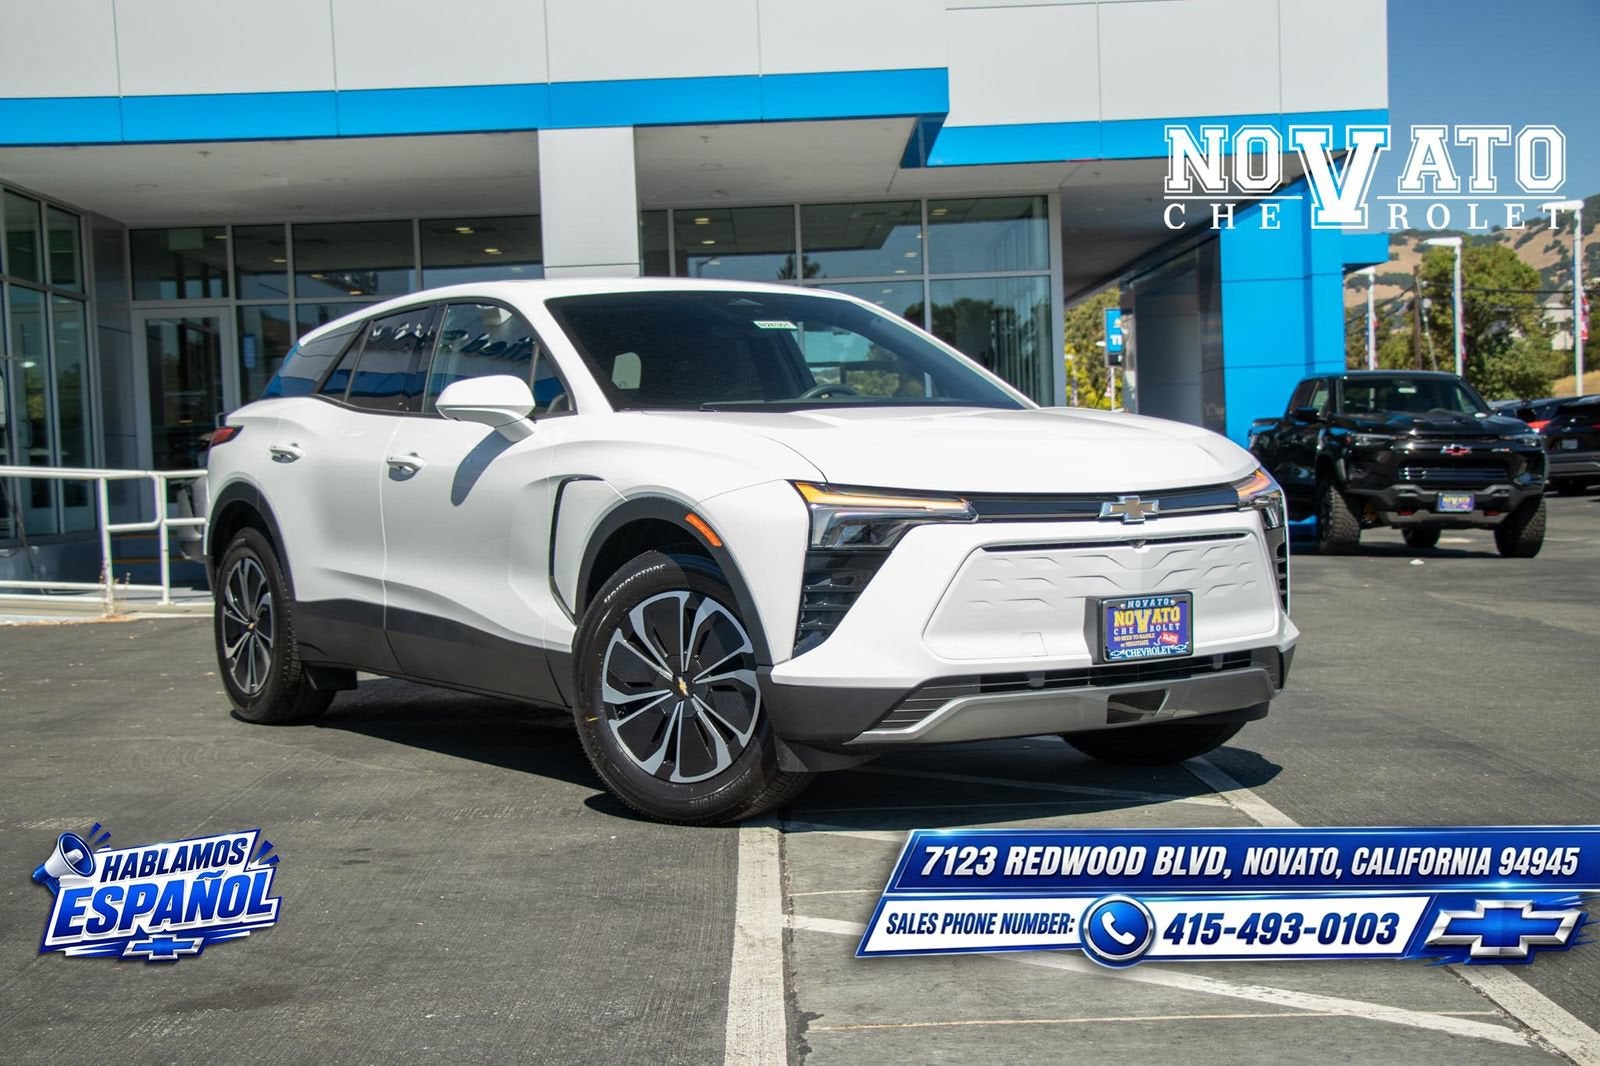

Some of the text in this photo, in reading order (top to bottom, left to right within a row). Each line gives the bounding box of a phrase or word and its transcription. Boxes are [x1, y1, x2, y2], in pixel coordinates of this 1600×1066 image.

[1127, 599, 1169, 608] NOVATO
[1113, 606, 1181, 633] NOVATO
[1126, 646, 1171, 657] CHEVROLET
